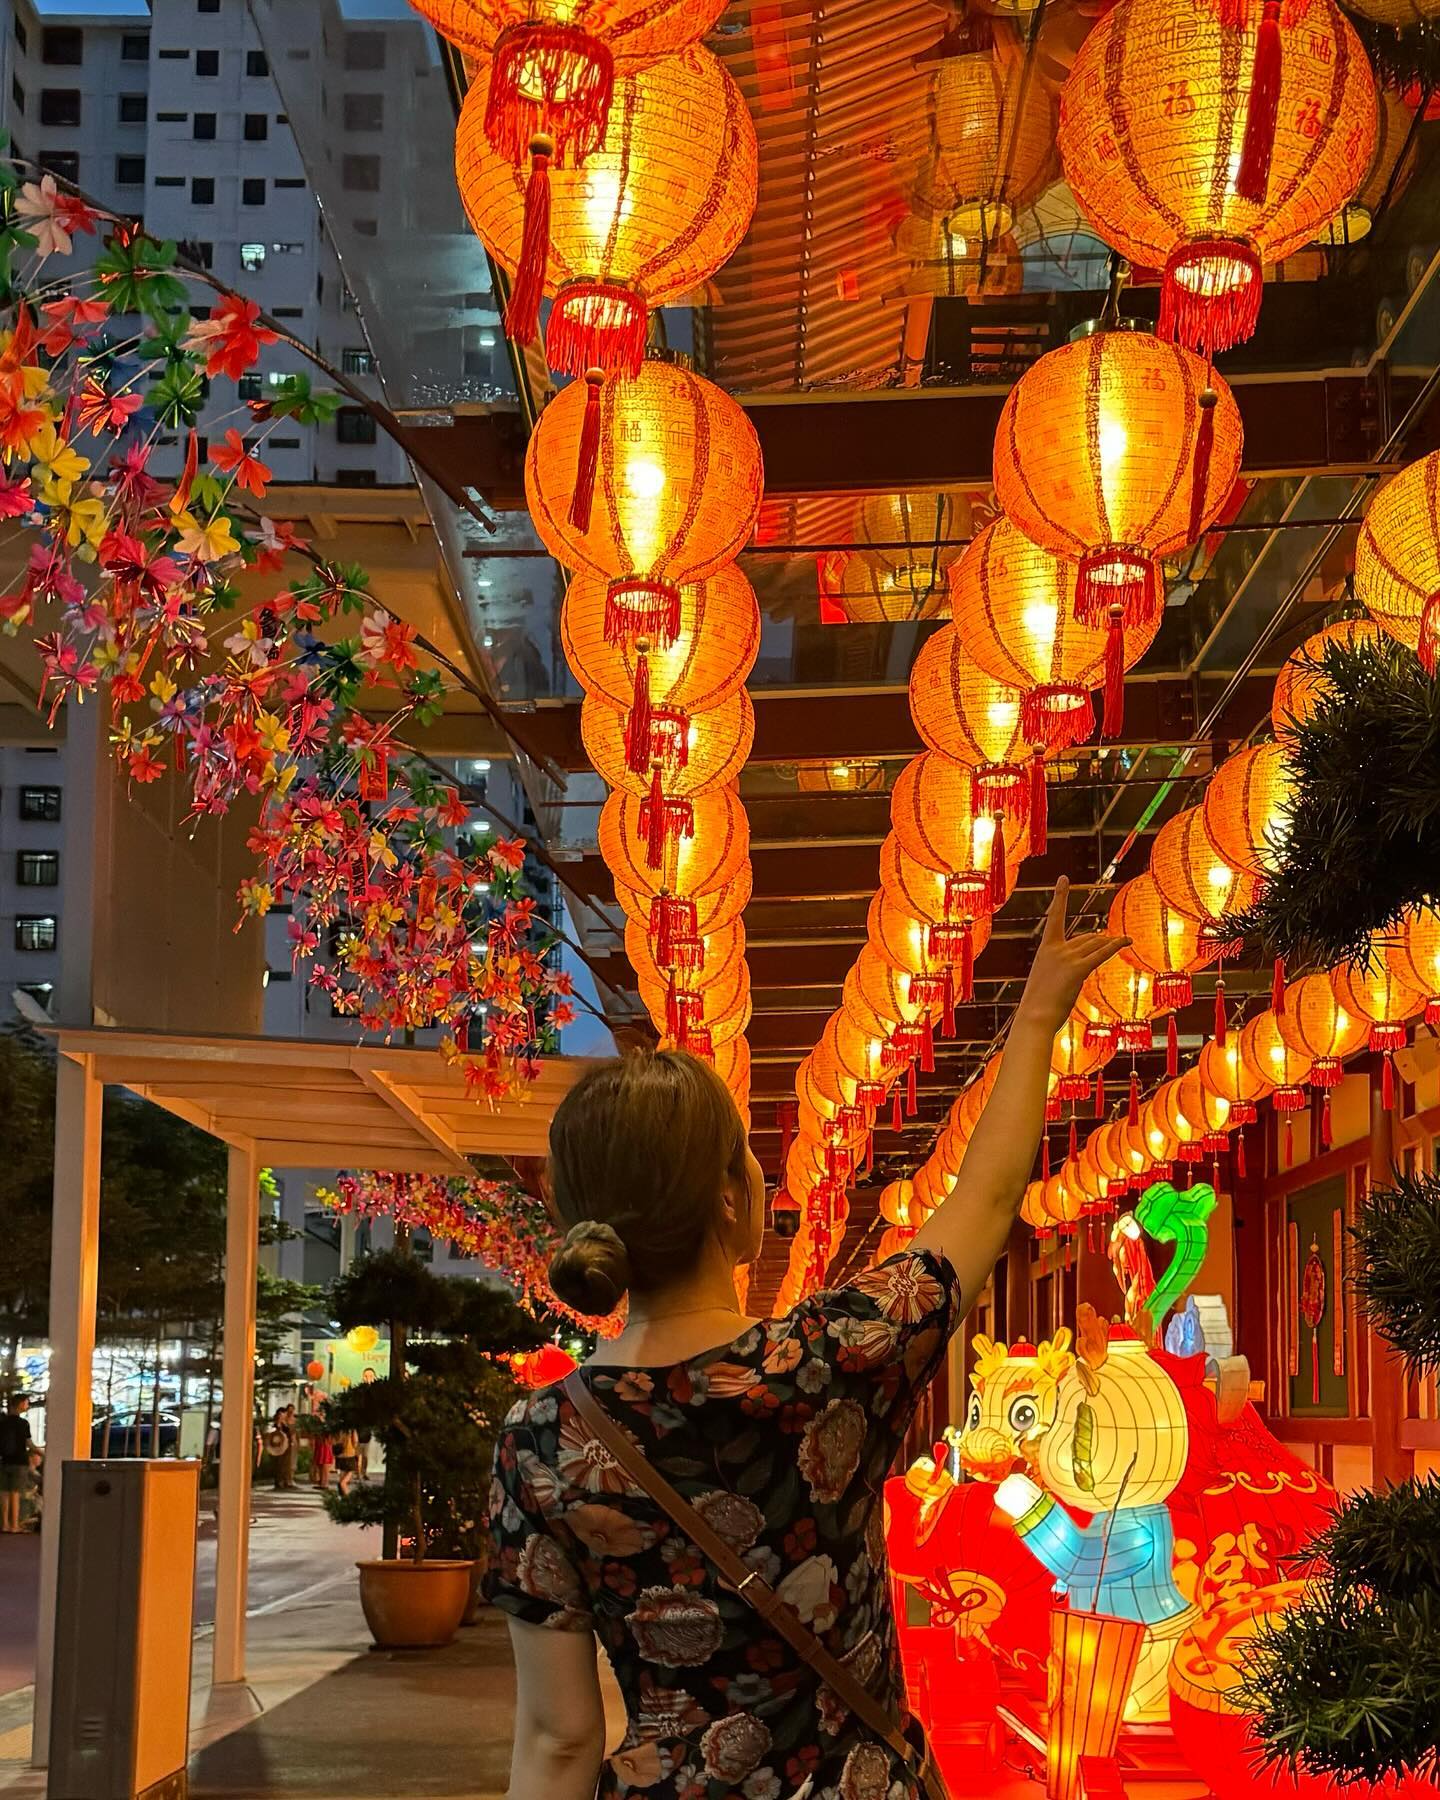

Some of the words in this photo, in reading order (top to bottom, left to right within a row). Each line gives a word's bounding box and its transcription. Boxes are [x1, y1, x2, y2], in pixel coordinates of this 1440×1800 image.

[1162, 79, 1196, 121] 福
[1294, 97, 1323, 139] 福
[1142, 368, 1166, 391] 福
[620, 420, 641, 443] 福
